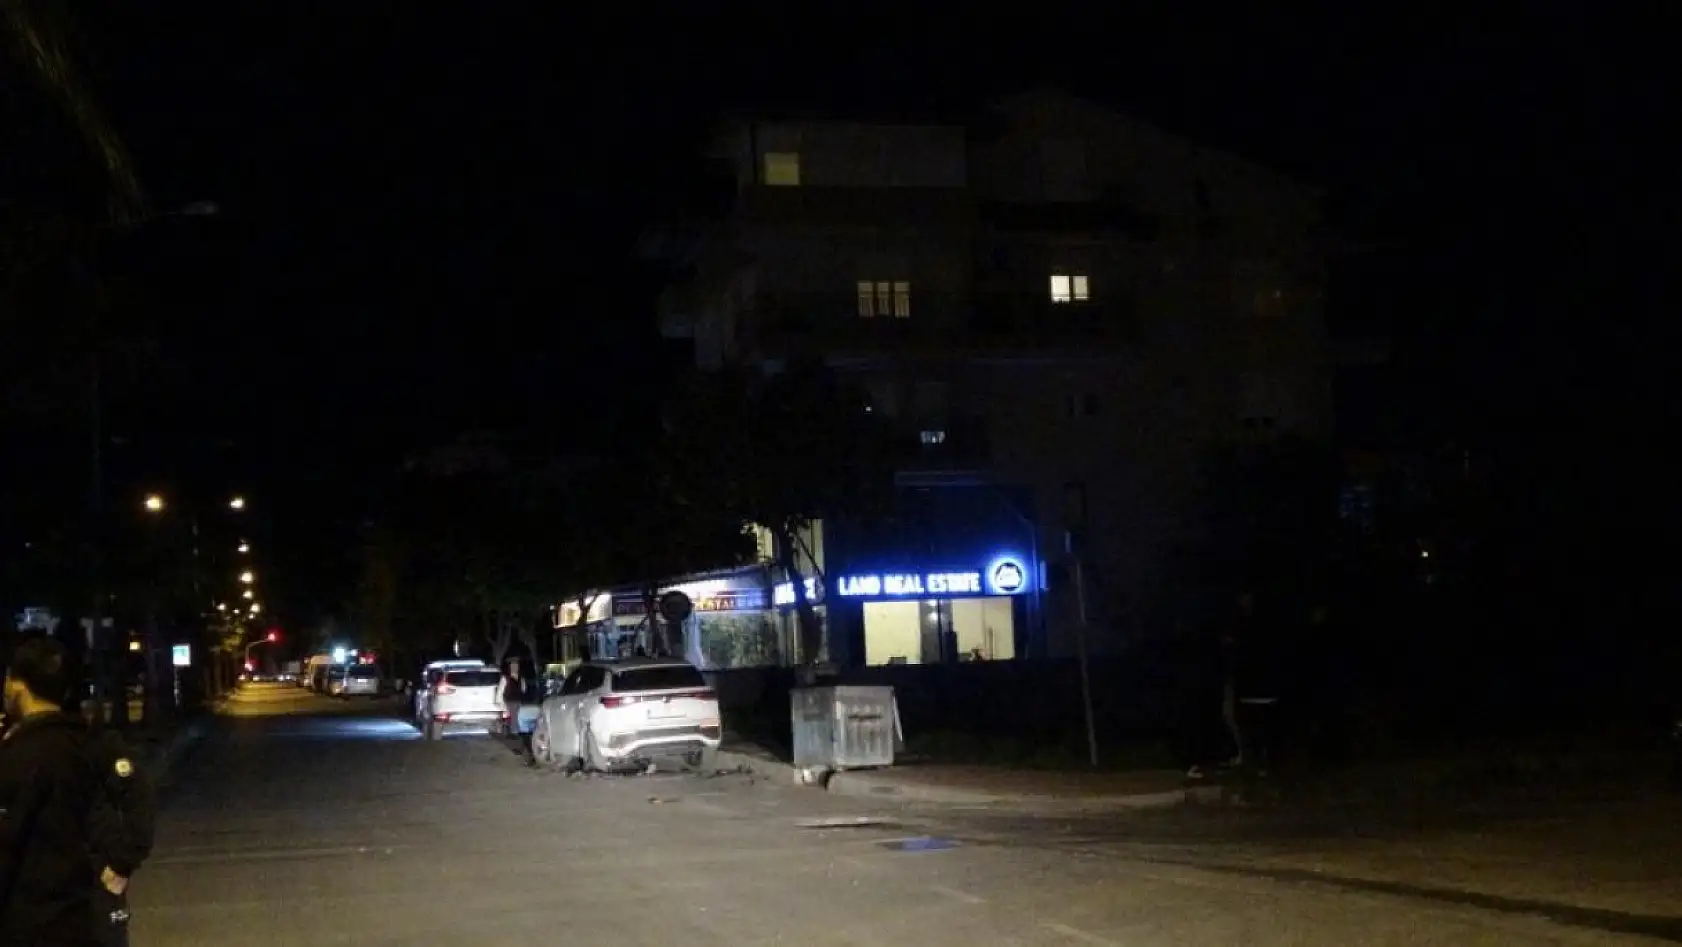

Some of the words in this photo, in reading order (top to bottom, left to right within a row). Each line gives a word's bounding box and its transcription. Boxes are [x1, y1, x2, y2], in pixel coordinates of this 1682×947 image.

[839, 576, 880, 596] LAND
[884, 574, 924, 595] REAL
[928, 573, 980, 593] ESTATE
